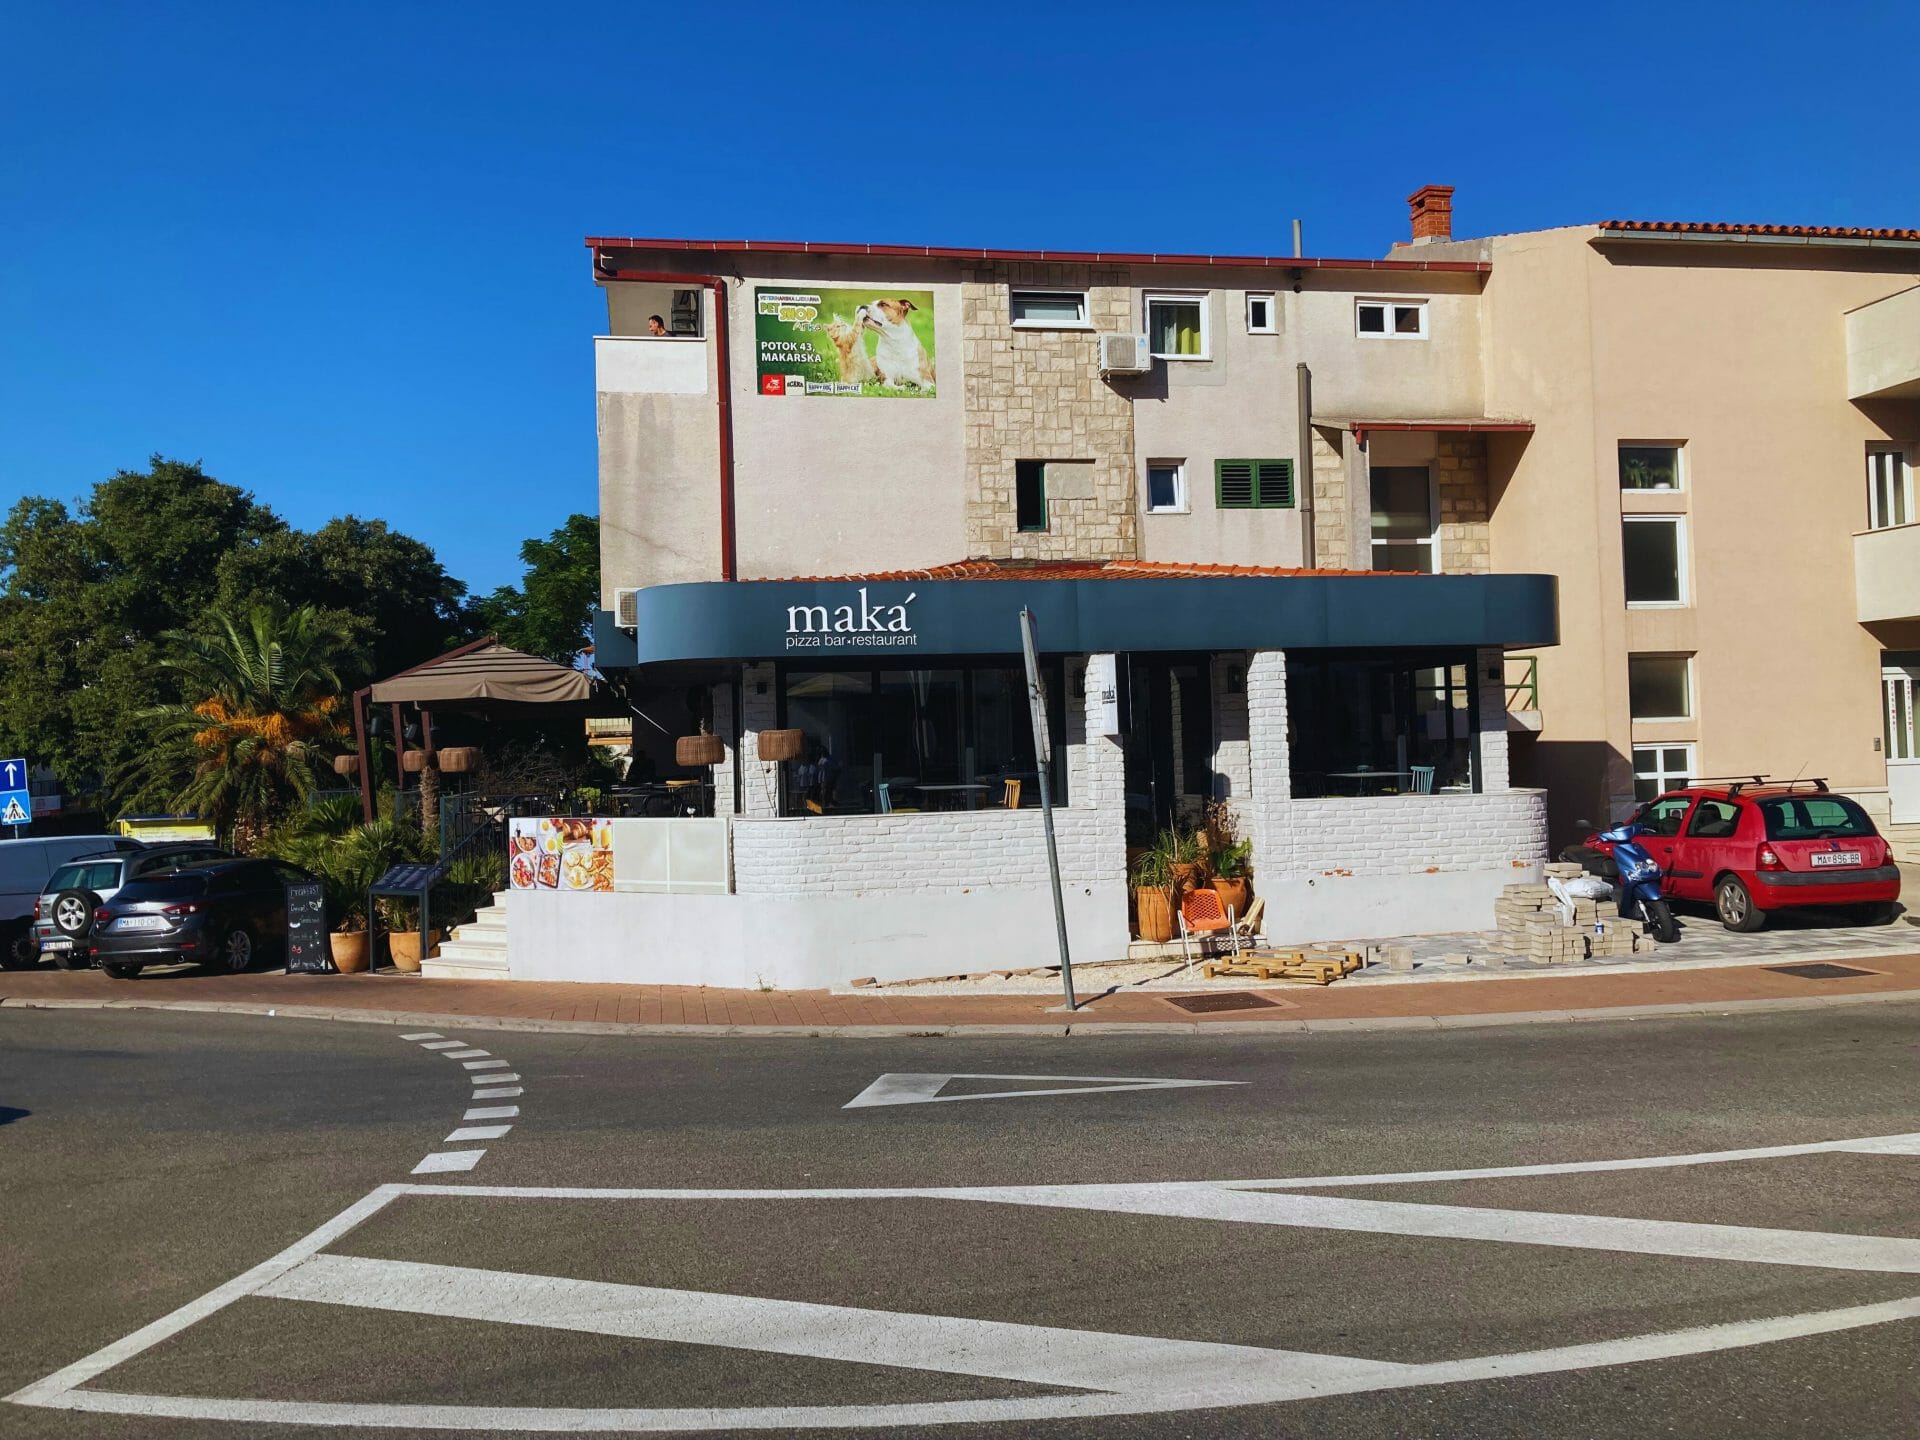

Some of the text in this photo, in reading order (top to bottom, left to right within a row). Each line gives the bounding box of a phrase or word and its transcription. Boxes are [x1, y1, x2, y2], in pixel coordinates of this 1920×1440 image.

[760, 302, 779, 313] PET
[780, 307, 816, 320] SHOP
[761, 341, 815, 353] POTOK 43,
[761, 352, 822, 363] MAKARSKA
[786, 634, 820, 650] pizza
[851, 633, 918, 646] restaurant
